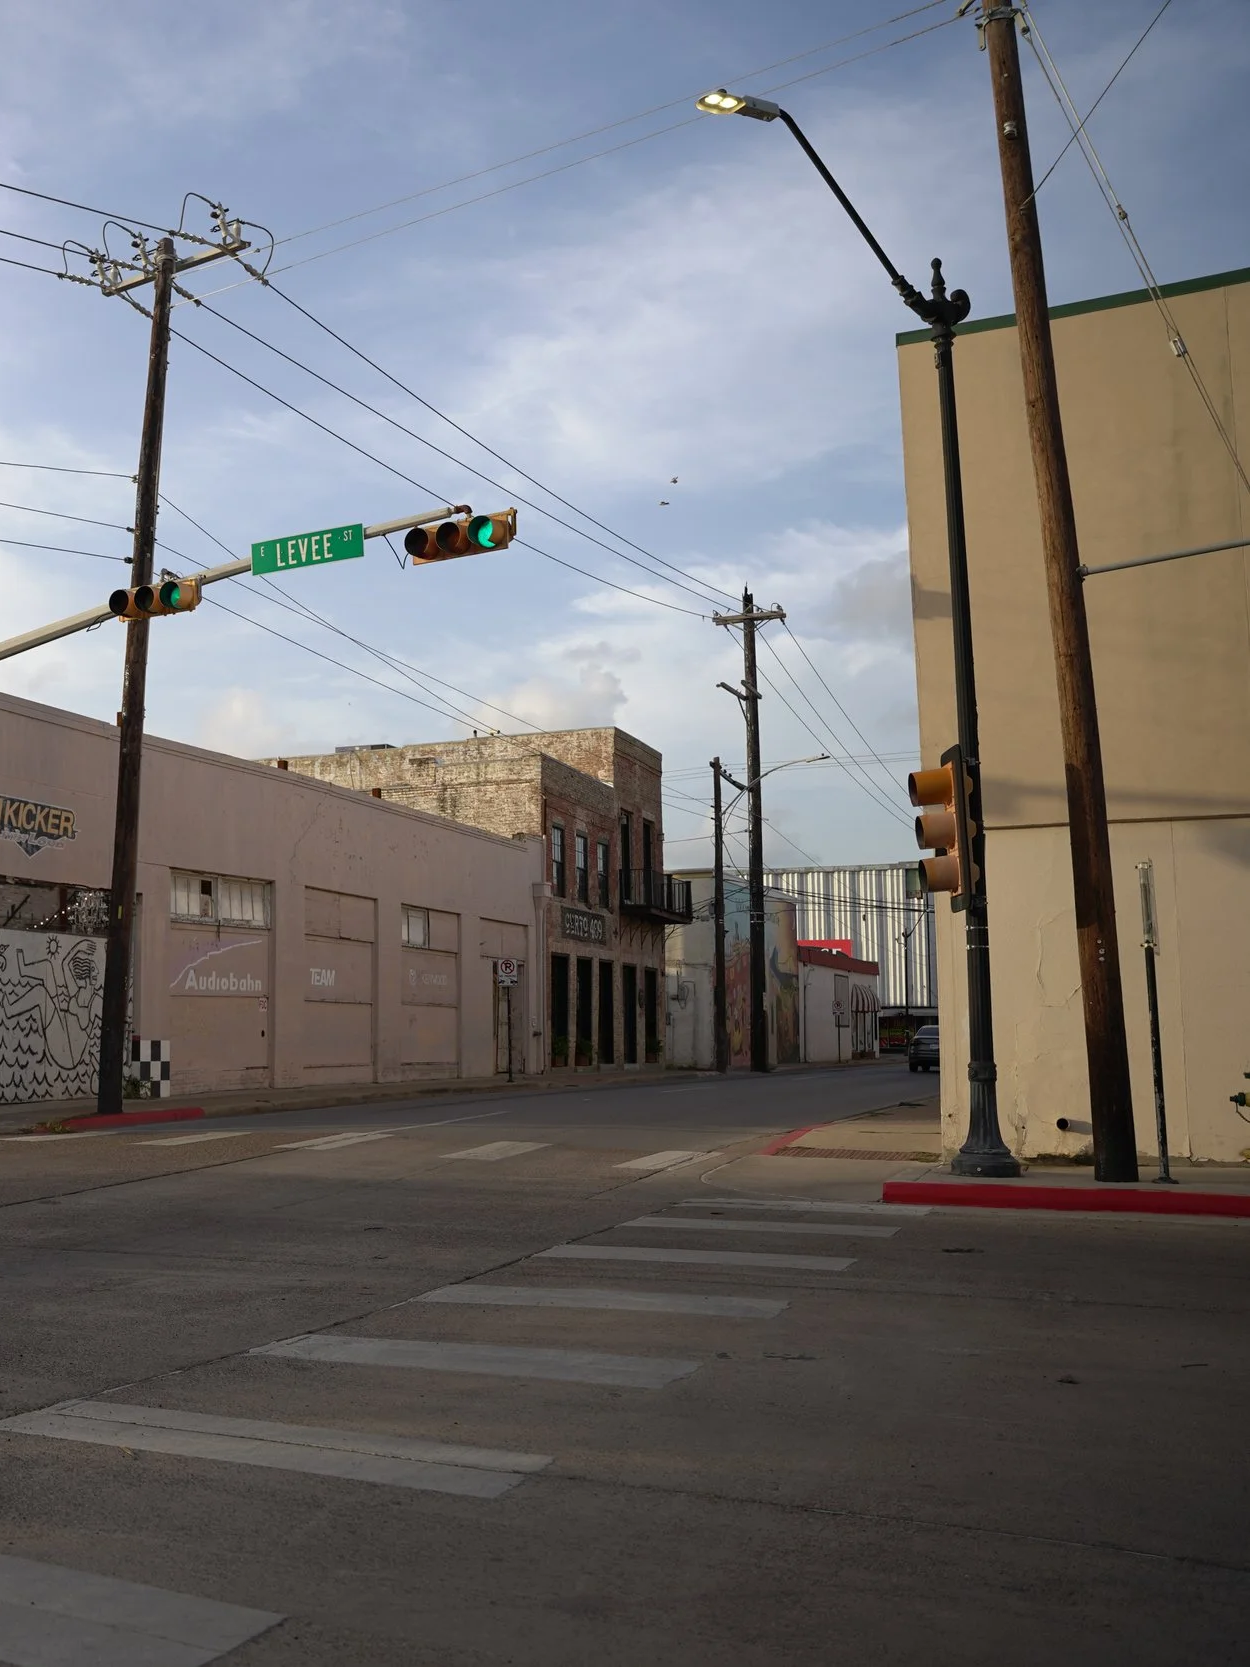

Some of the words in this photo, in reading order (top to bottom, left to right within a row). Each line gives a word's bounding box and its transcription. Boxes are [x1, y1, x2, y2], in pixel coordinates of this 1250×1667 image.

[260, 546, 265, 557] E
[276, 533, 333, 567] LEVEE
[343, 529, 353, 542] ST
[4, 800, 74, 838] KICKER
[185, 969, 262, 991] Audiobahn
[310, 968, 336, 986] TEAM
